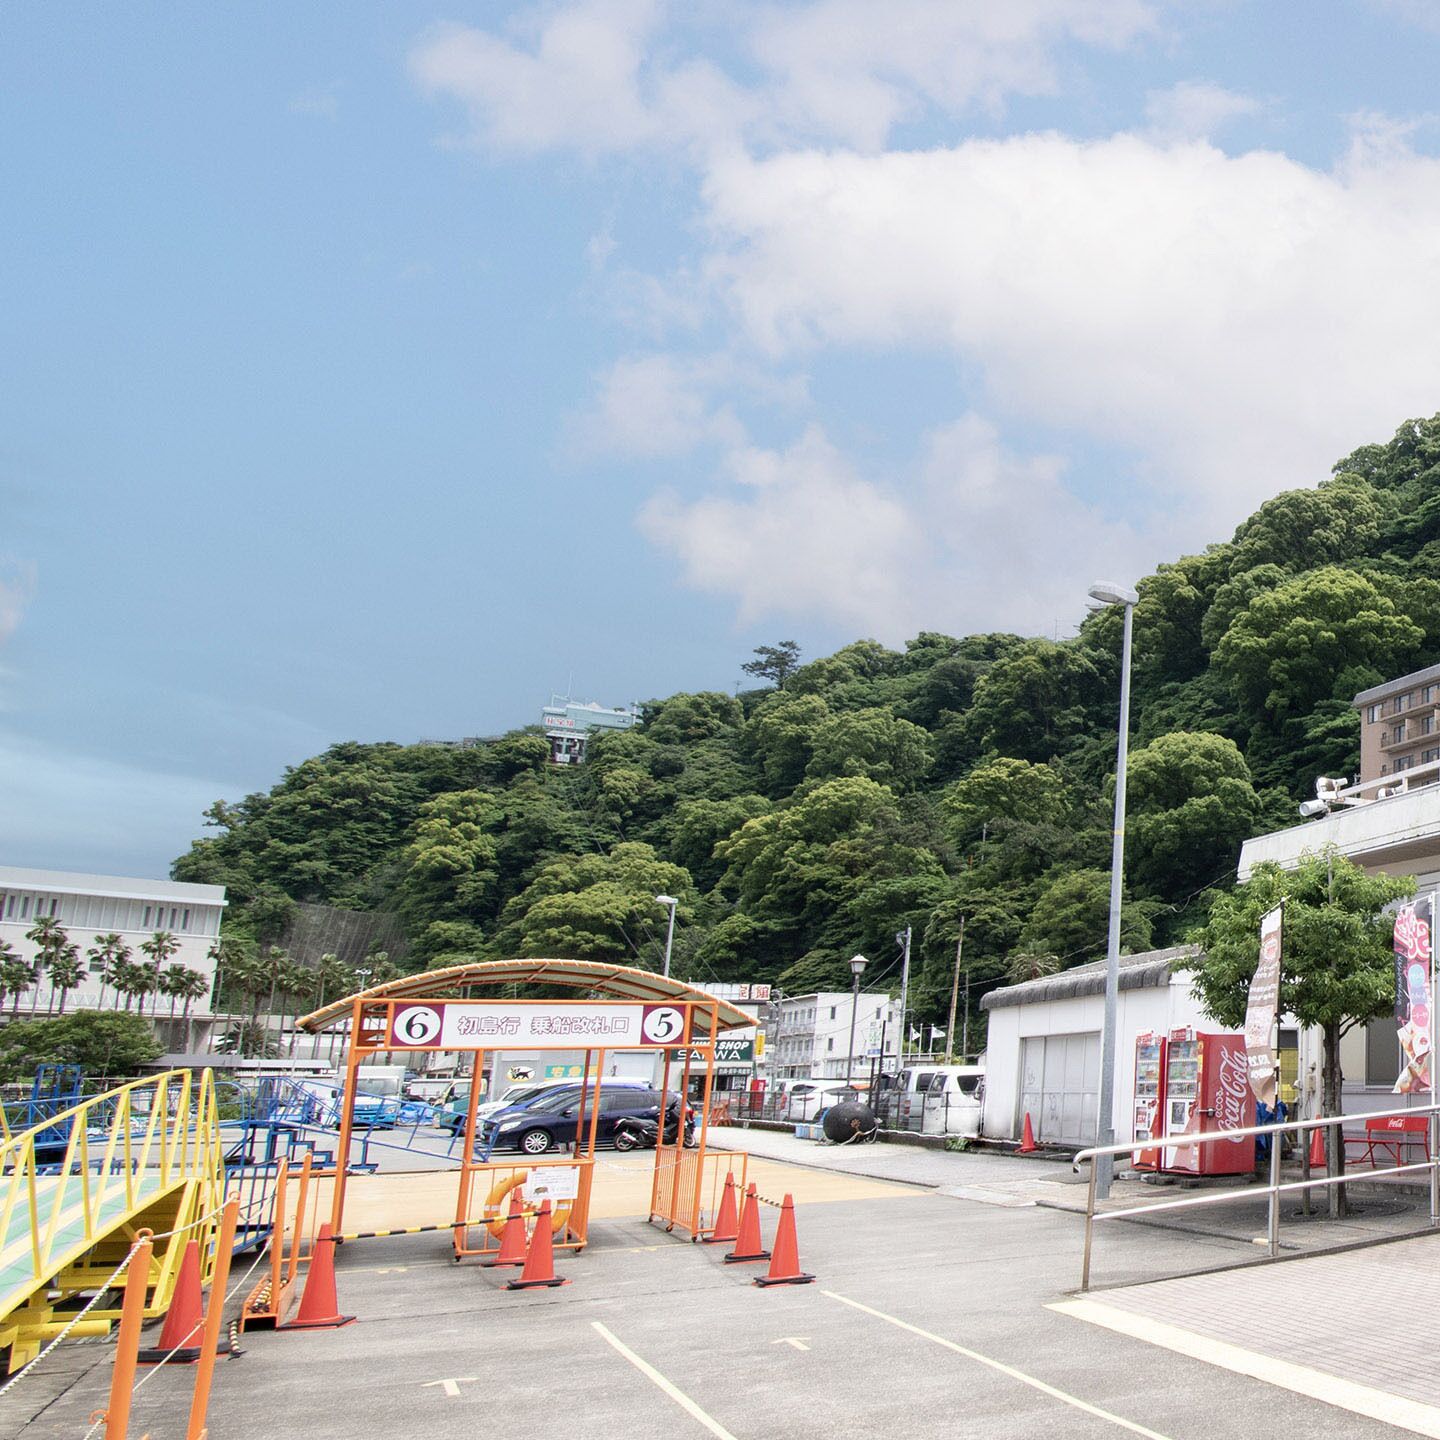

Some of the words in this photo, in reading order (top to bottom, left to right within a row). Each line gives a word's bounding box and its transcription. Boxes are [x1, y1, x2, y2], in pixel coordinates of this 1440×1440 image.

[405, 1012, 429, 1039] 6
[458, 1016, 520, 1035] 初島行
[530, 1016, 630, 1035] 乗船改札口
[653, 1012, 673, 1038] 5
[718, 1041, 750, 1050] SHOP
[677, 1050, 741, 1060] SAWA
